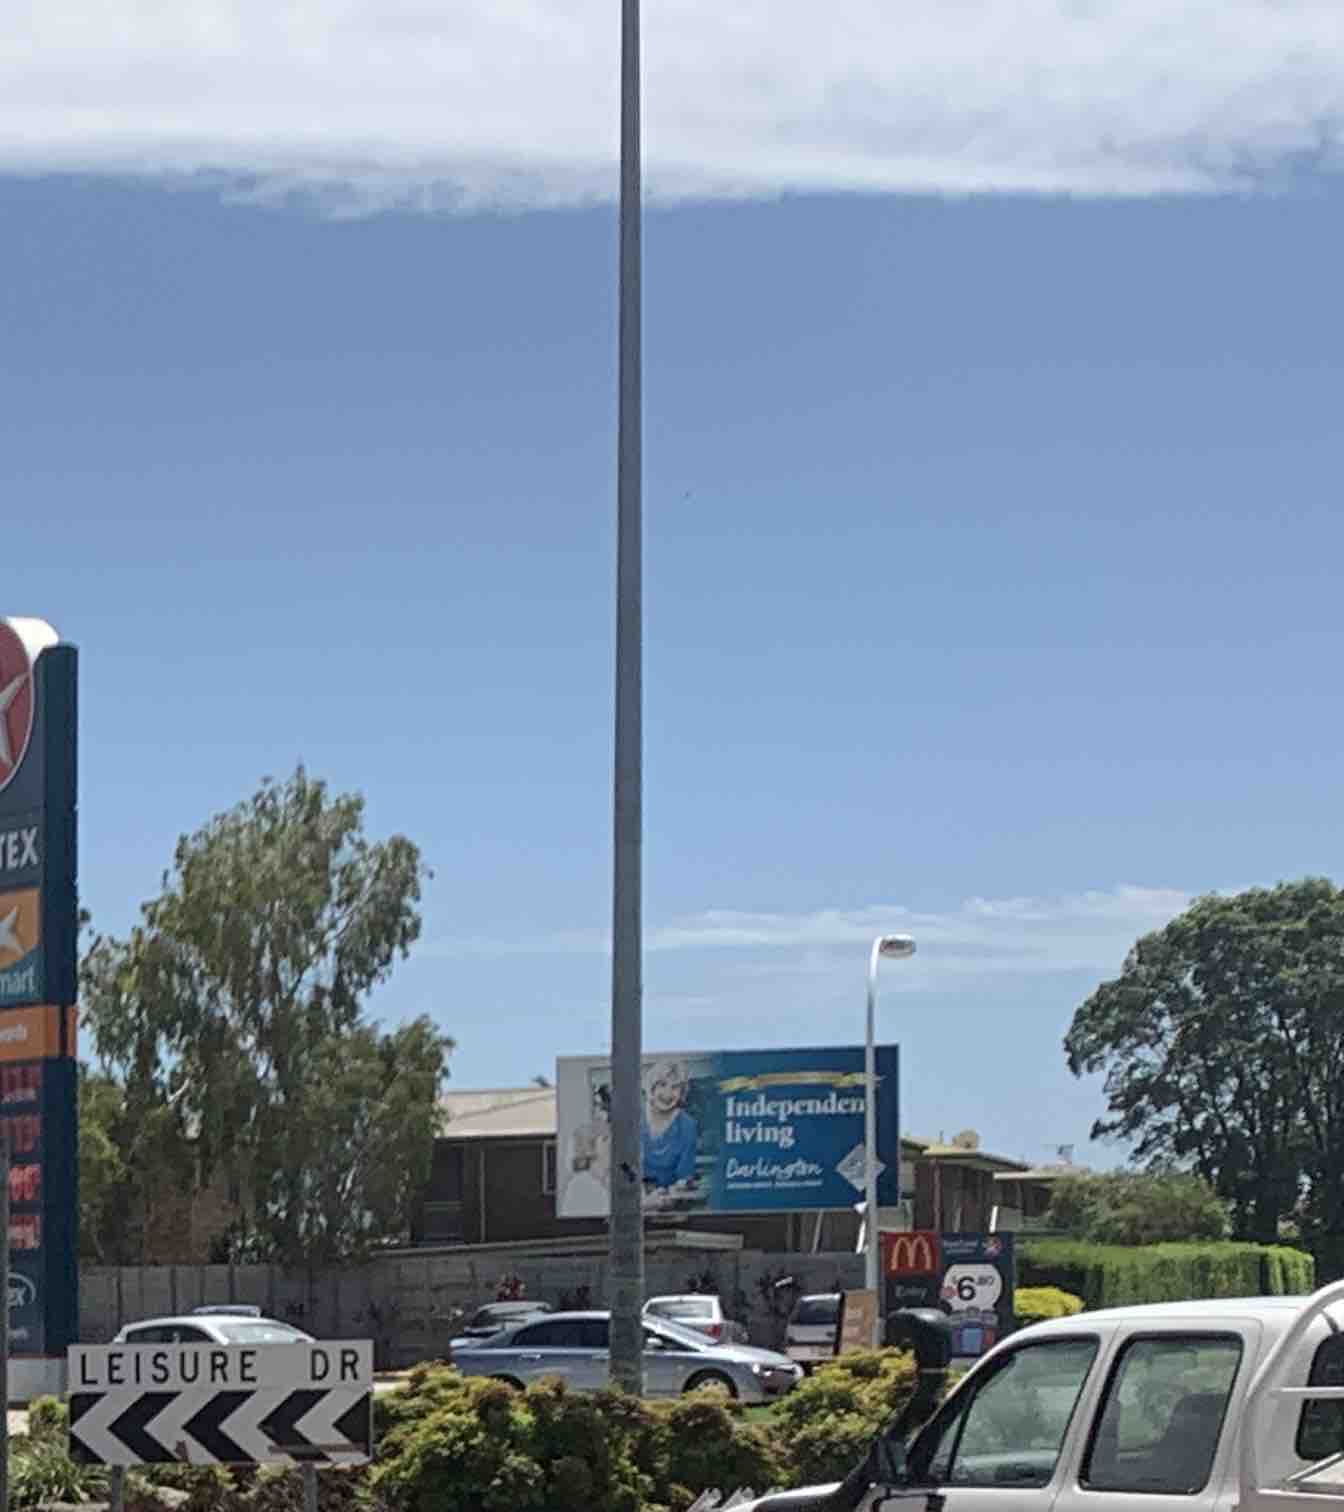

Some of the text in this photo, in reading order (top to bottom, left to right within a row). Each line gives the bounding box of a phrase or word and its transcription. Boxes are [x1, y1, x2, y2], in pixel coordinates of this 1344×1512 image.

[726, 1092, 865, 1121] Independen
[726, 1120, 796, 1149] living
[80, 1349, 360, 1385] LEISURE DR
